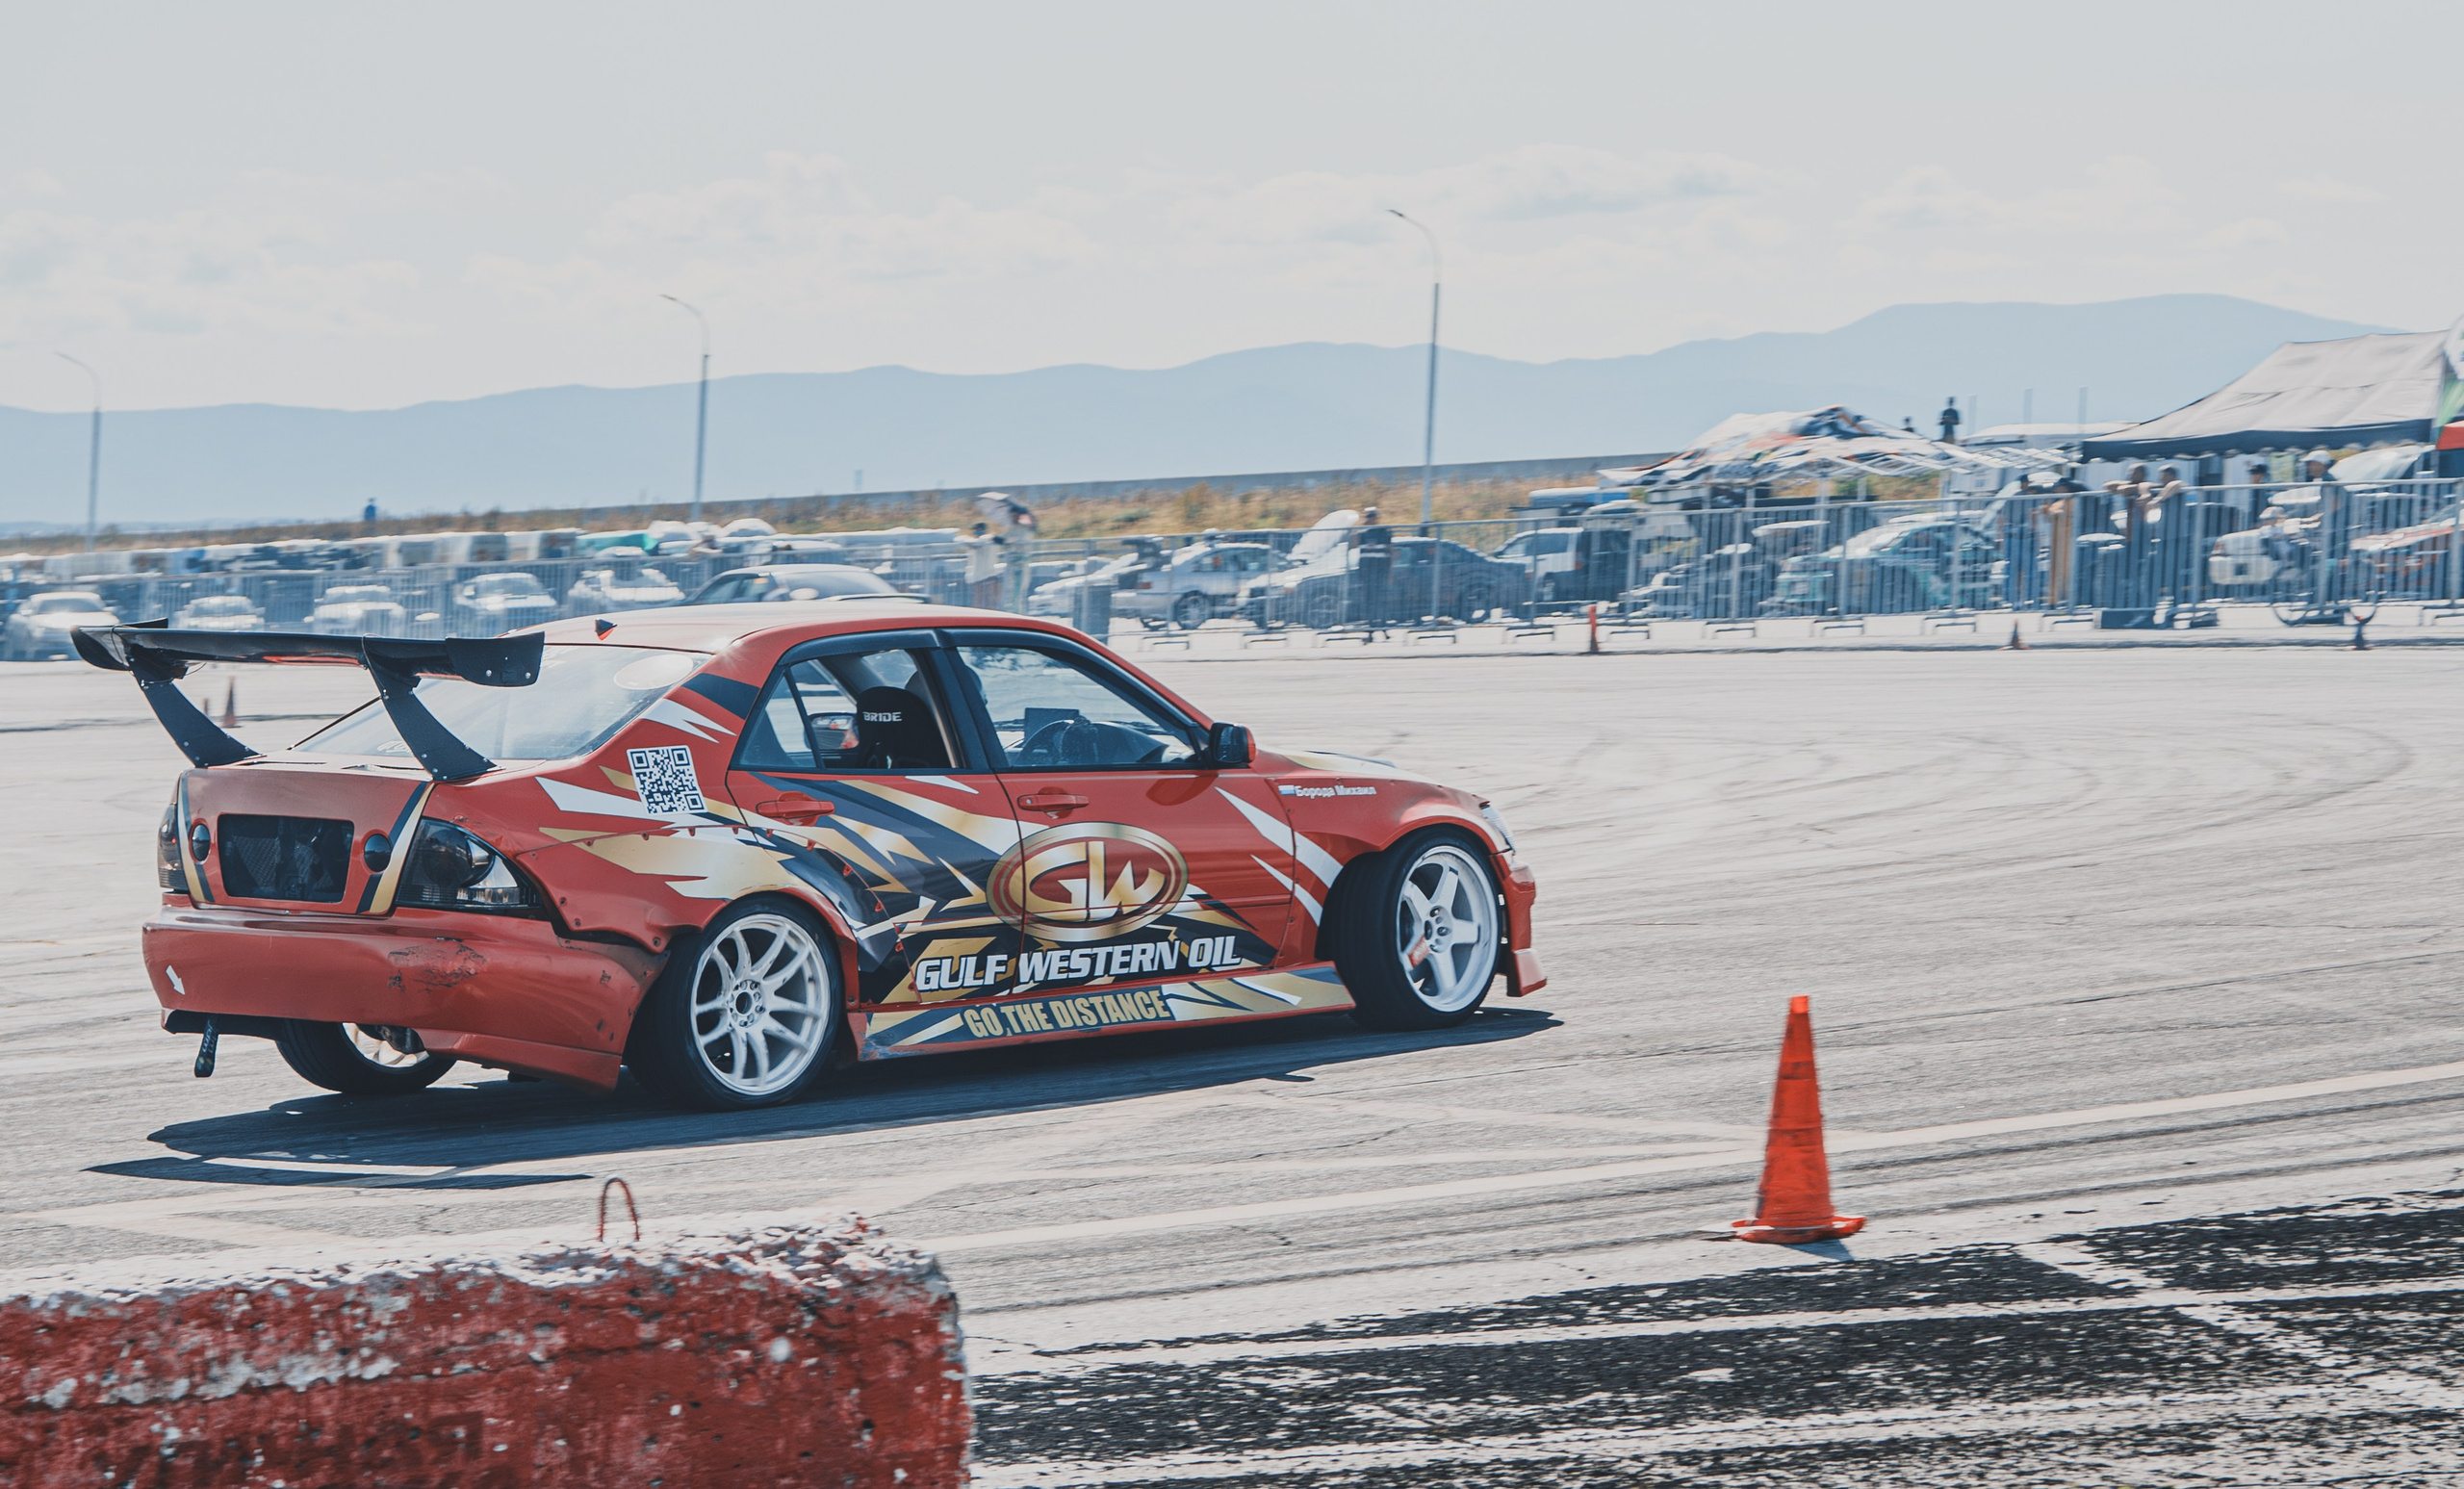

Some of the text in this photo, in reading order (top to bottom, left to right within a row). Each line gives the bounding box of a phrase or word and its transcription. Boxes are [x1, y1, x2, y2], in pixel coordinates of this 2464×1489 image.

[862, 711, 903, 722] BRIDE
[1295, 784, 1336, 799] Борода
[1008, 840, 1167, 923] GW
[915, 936, 1242, 991] GULF WESTERN OIL
[963, 989, 1171, 1039] GO THE DISTANCE
